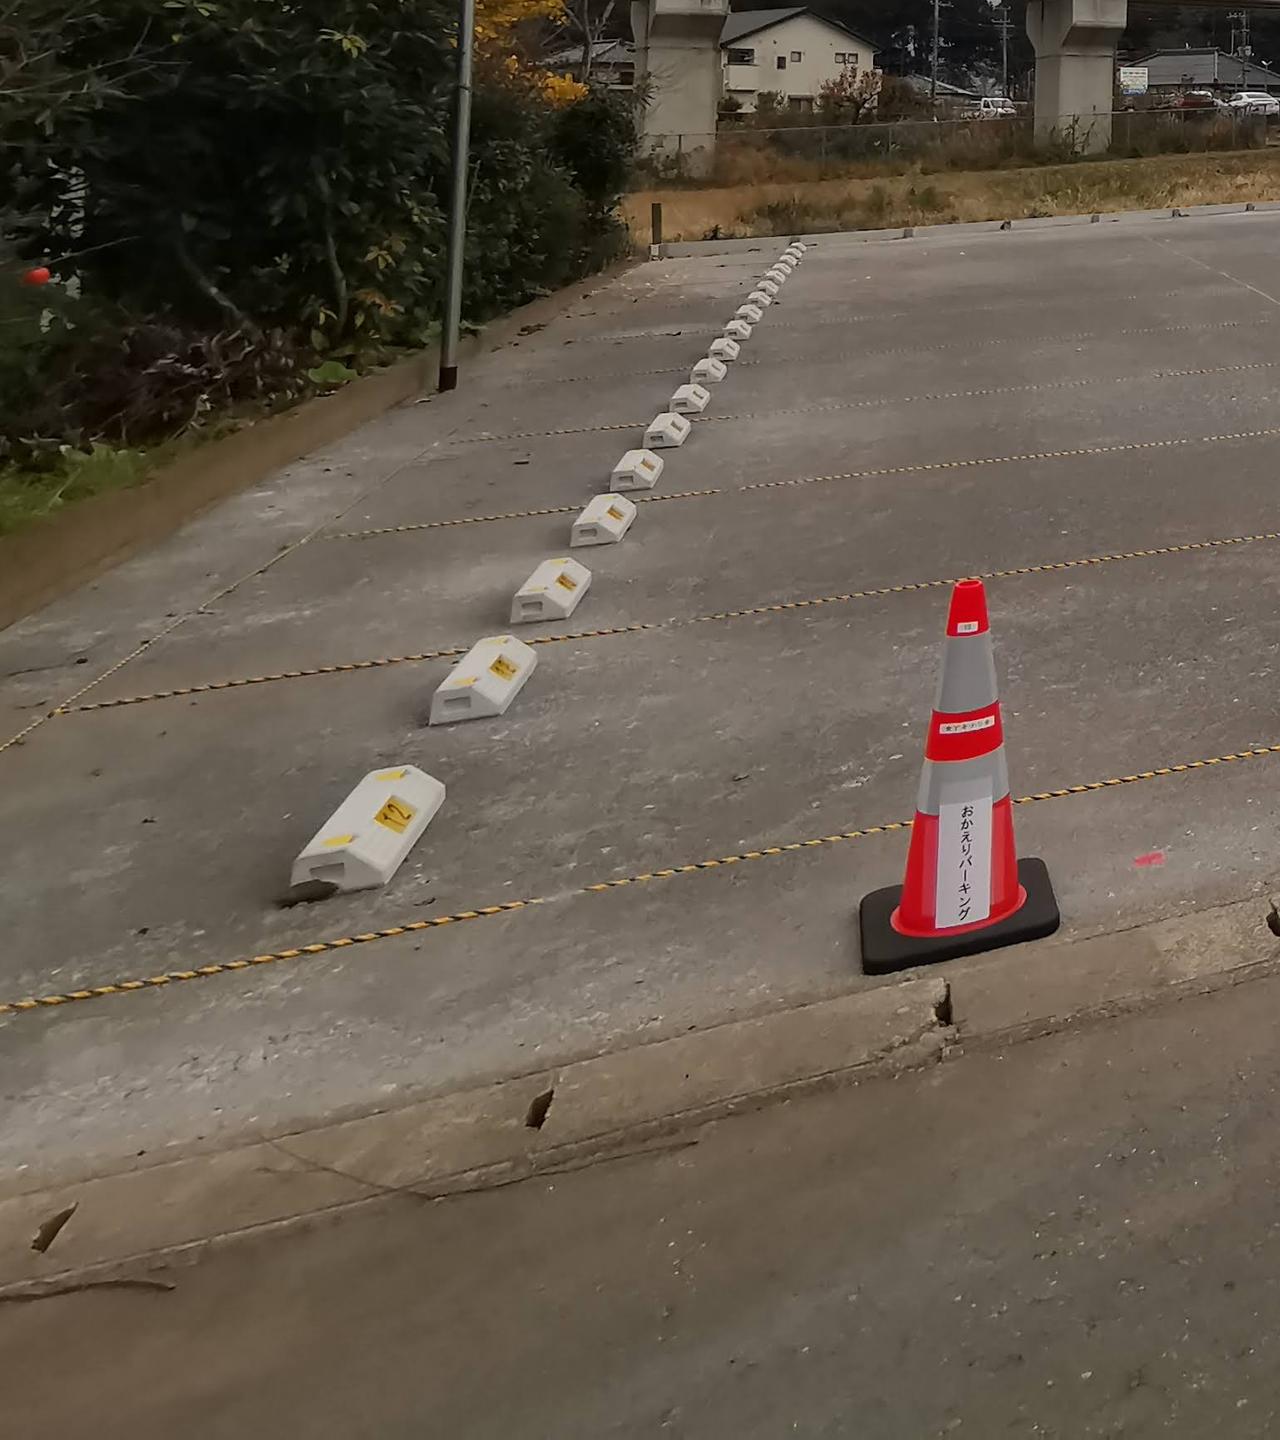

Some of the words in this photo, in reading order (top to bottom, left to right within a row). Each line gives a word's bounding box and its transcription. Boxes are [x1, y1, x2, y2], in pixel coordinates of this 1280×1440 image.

[957, 805, 975, 921] おかえりパーキング
